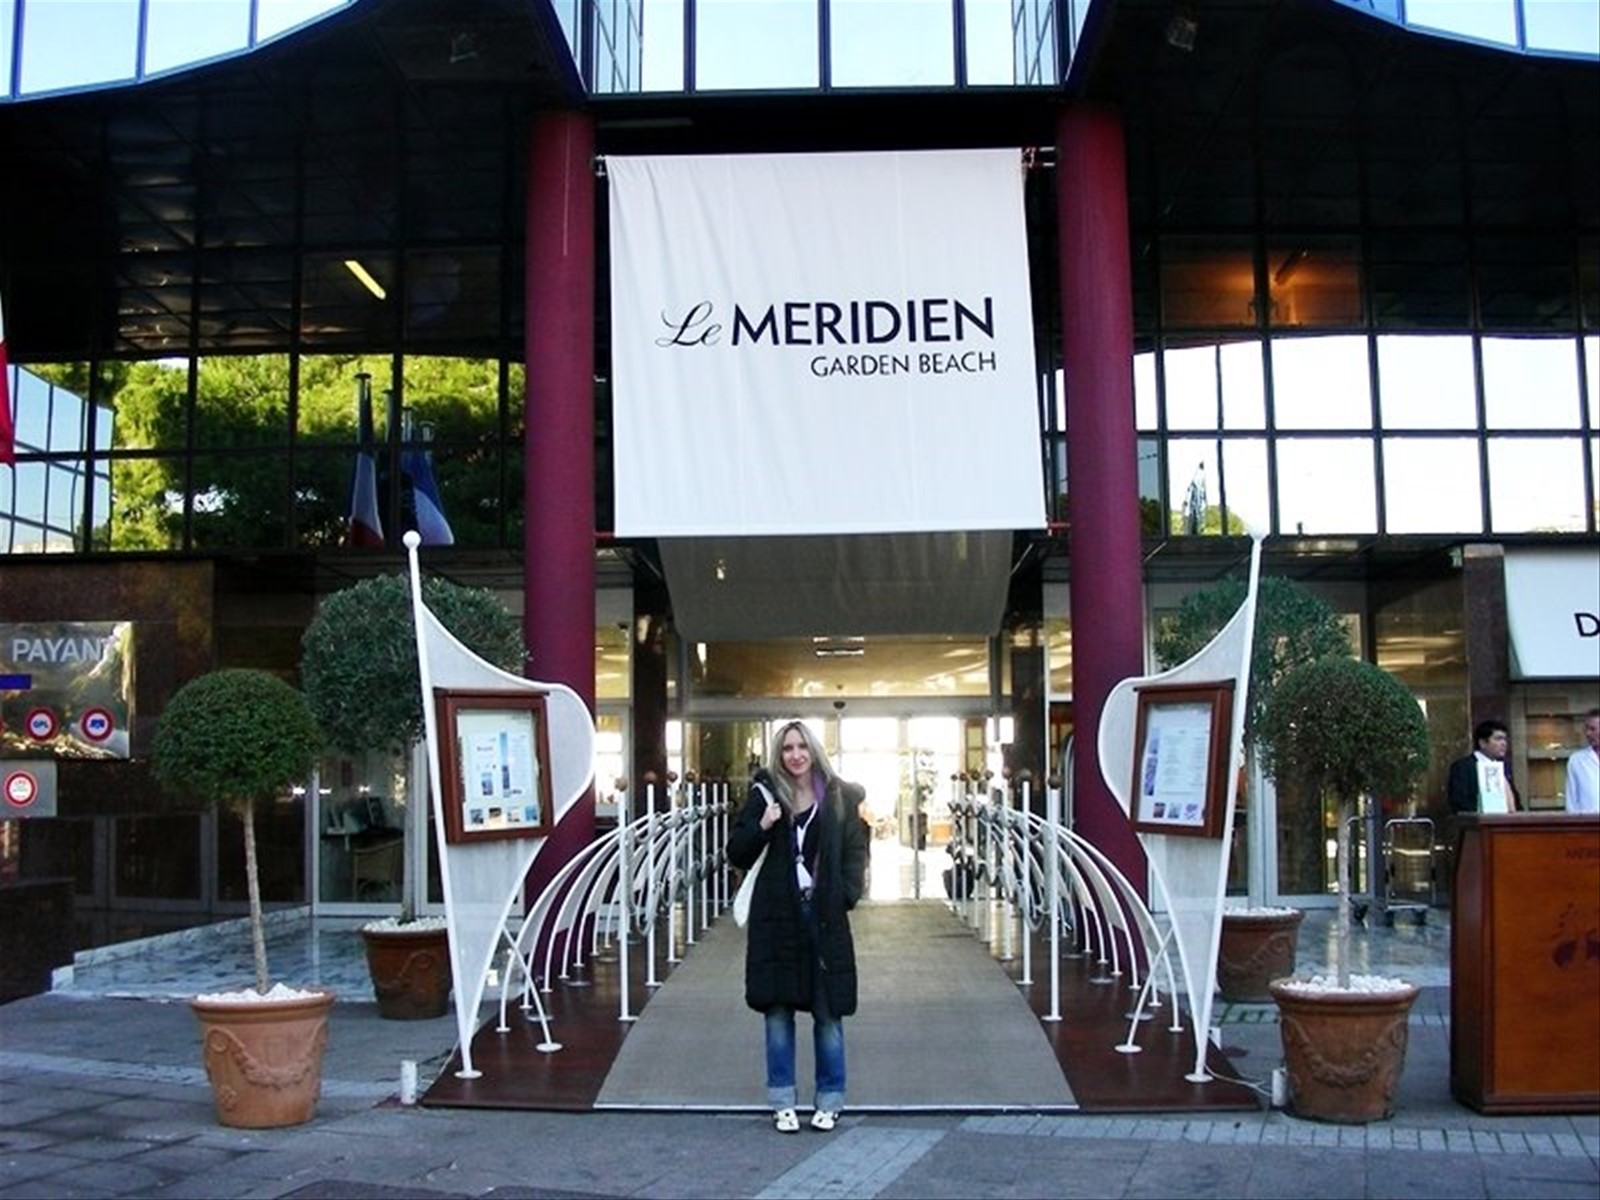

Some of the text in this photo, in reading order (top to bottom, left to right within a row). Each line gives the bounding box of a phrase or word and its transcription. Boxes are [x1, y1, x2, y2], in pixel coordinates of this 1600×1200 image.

[655, 297, 995, 347] Le MERIDIEN
[810, 352, 997, 377] GARDEN BEACH
